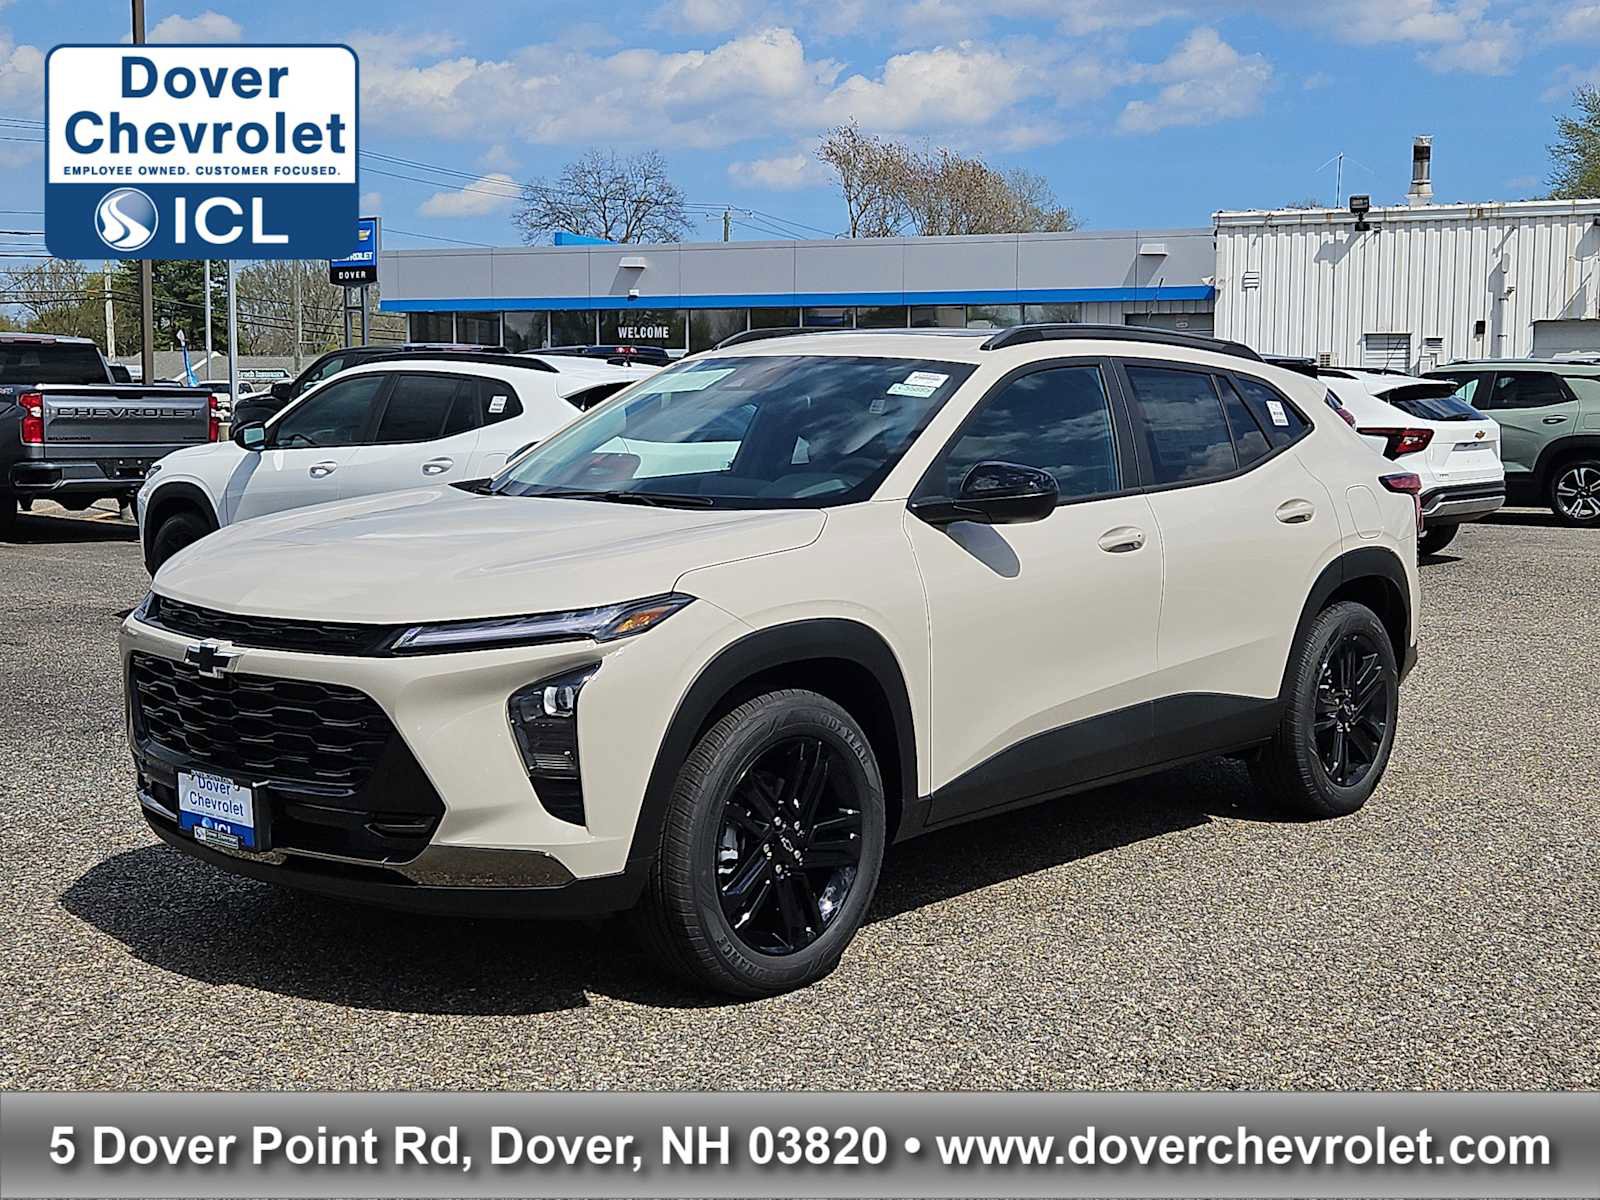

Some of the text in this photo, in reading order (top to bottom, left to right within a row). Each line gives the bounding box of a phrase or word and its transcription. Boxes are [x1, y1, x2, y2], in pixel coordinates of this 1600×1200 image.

[338, 271, 366, 279] DOVER
[617, 326, 670, 339] WELCOME
[57, 407, 200, 419] CHEVROLET
[198, 775, 231, 795] Dover
[189, 791, 244, 816] Chevrolet
